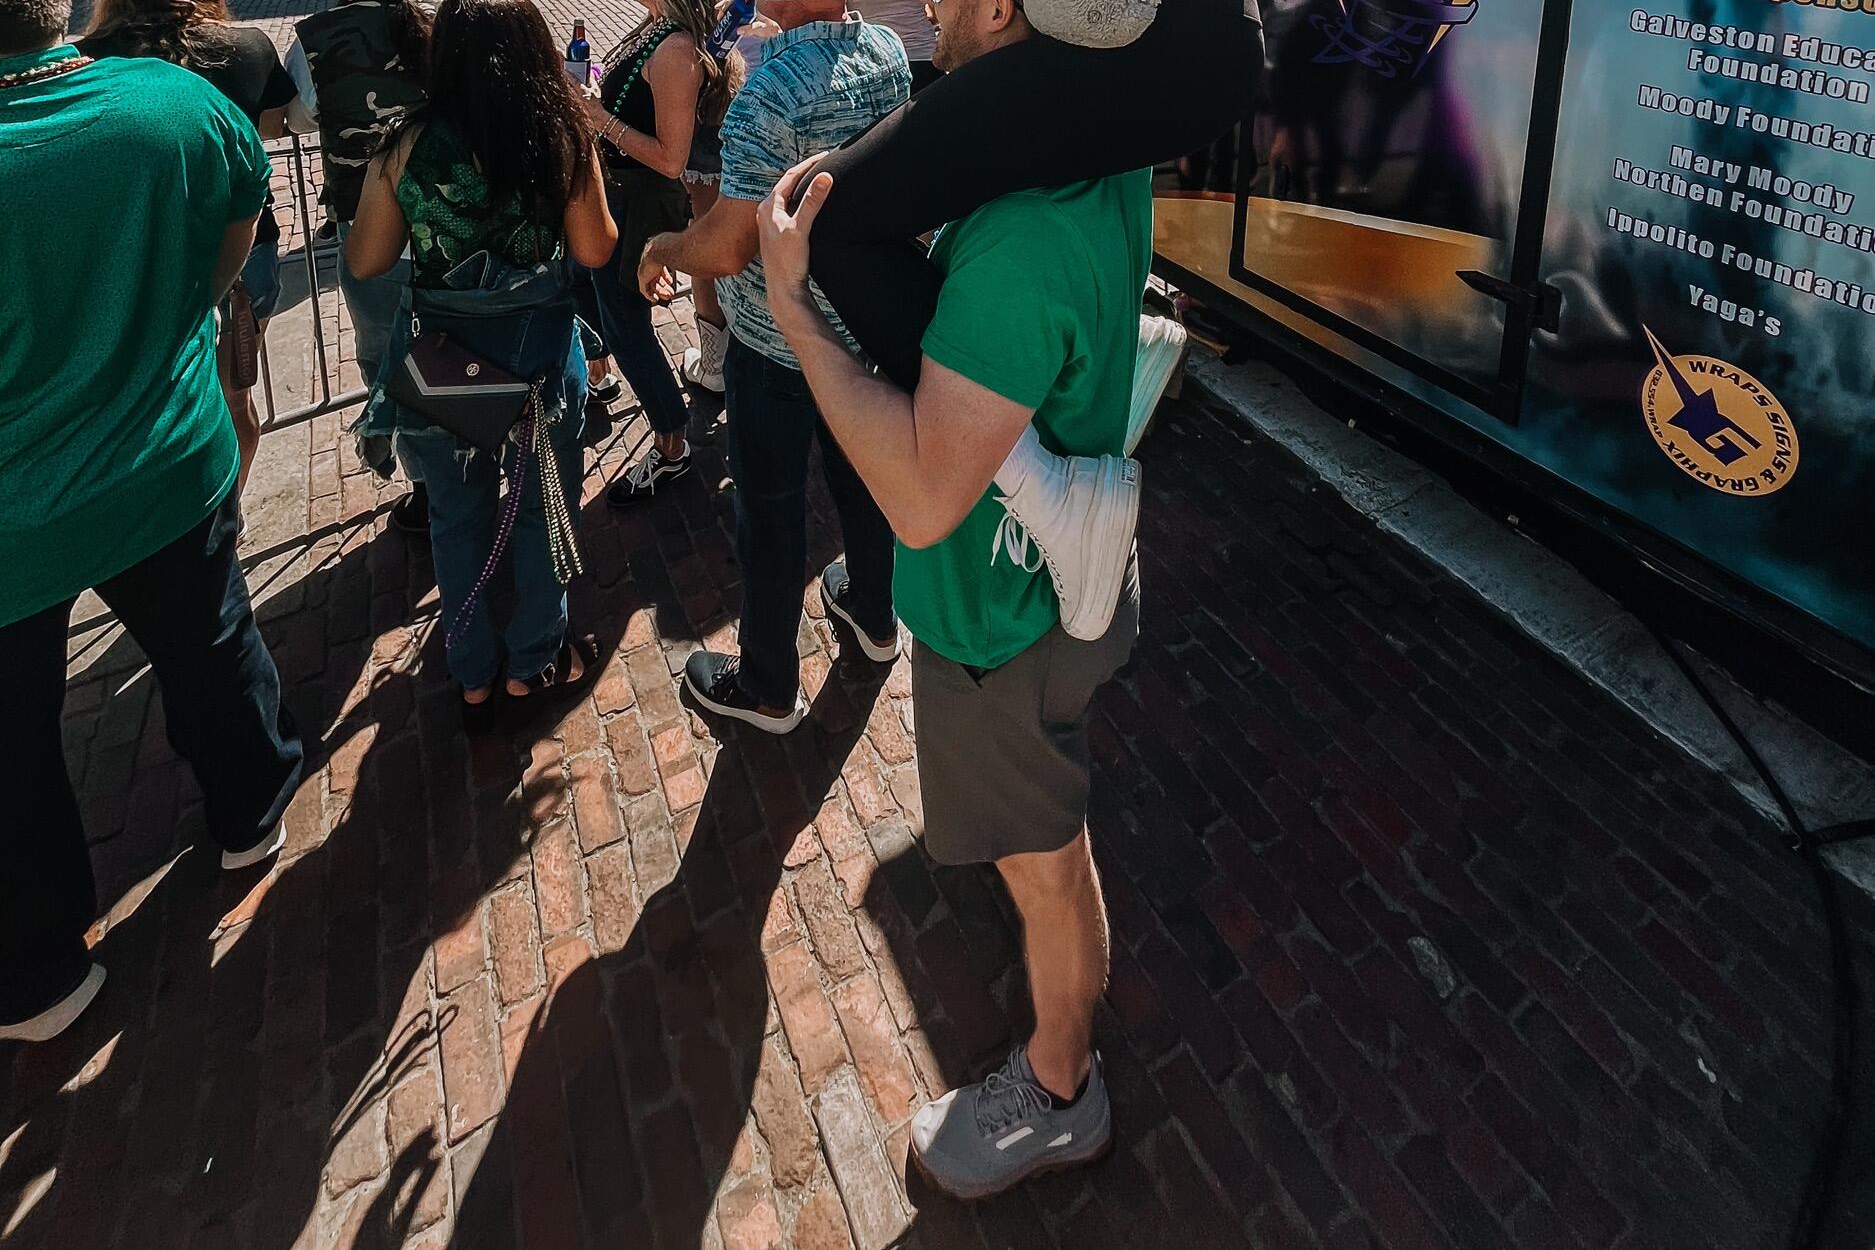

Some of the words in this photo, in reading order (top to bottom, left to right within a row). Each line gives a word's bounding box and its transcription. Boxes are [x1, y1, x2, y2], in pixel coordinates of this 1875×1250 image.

[714, 11, 732, 37] ULTRA
[1631, 10, 1775, 53] Galveston
[1688, 49, 1870, 103] Foundation
[1639, 85, 1730, 125] Moody
[1669, 145, 1741, 183] Mary
[1747, 165, 1854, 214] Moody
[1614, 159, 1724, 208] Northen
[1730, 192, 1875, 252] Foundati
[1607, 208, 1715, 259] Ippolito
[1688, 284, 1782, 336] Yaga's
[1688, 360, 1772, 407] WRAPS
[1662, 440, 1760, 492] GRAPHIX
[1765, 411, 1792, 474] SIGNS
[1760, 468, 1776, 485] &
